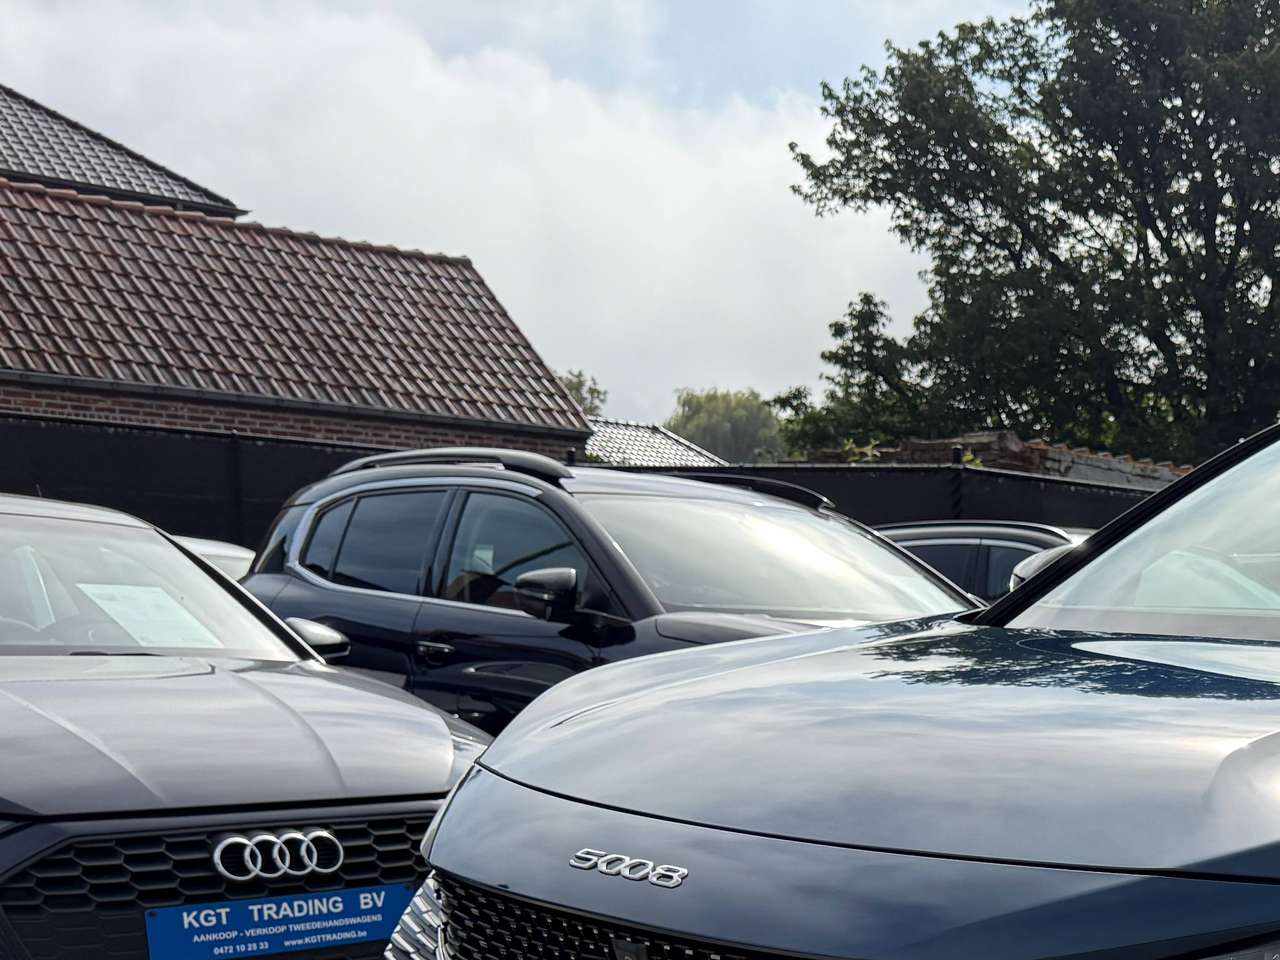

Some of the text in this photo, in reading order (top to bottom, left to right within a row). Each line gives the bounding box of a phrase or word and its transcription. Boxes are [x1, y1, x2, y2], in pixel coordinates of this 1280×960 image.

[569, 848, 689, 889] 5008
[182, 891, 386, 930] KGT TRADING BV
[193, 930, 238, 944] AANKOOP
[244, 924, 287, 937] VERKOOP
